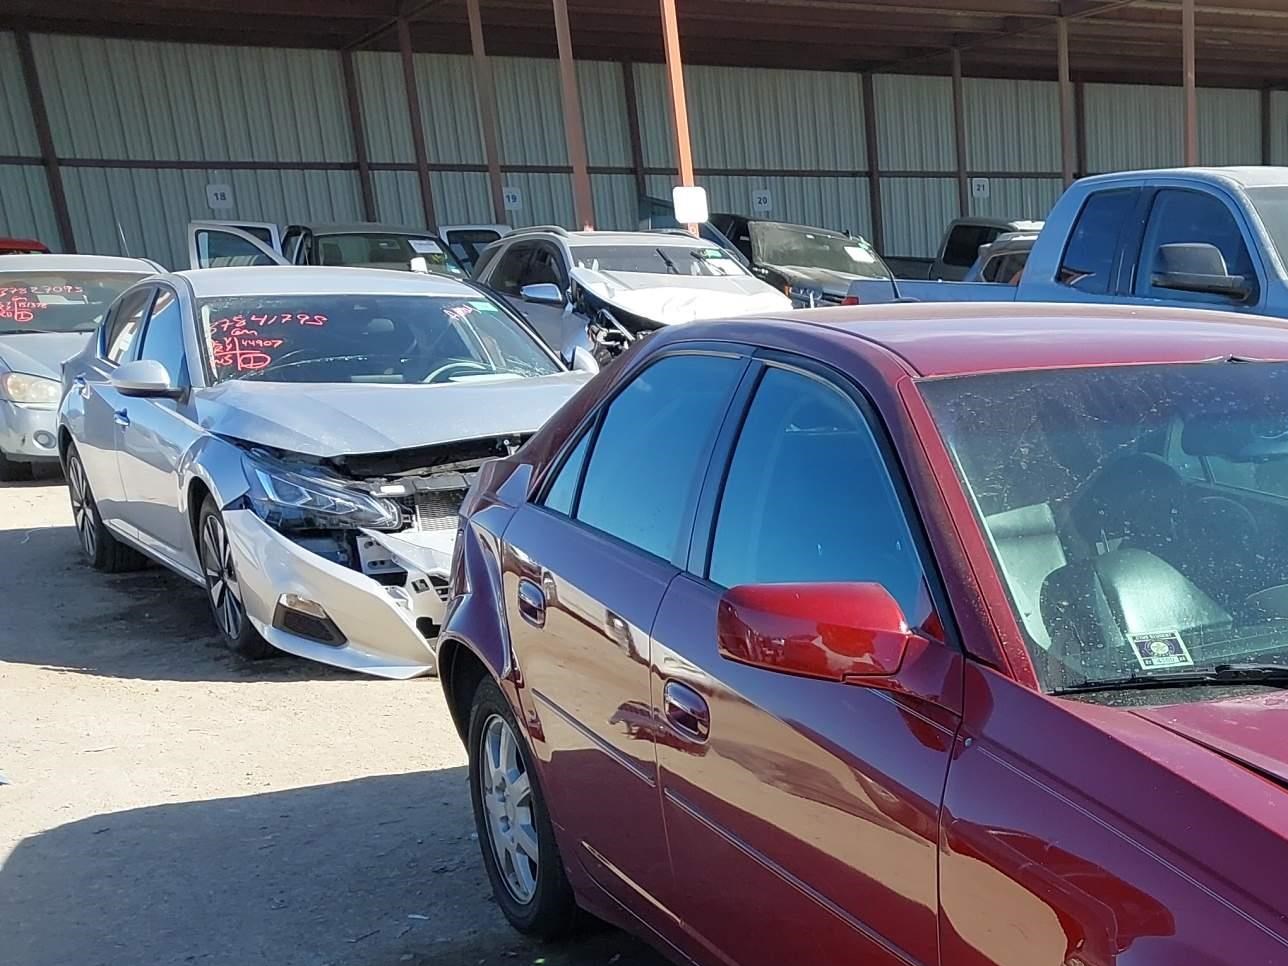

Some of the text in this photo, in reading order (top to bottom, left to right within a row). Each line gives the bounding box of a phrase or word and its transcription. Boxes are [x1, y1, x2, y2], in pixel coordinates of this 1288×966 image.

[213, 191, 226, 200] 18
[505, 194, 517, 203] 19
[756, 196, 768, 205] 20
